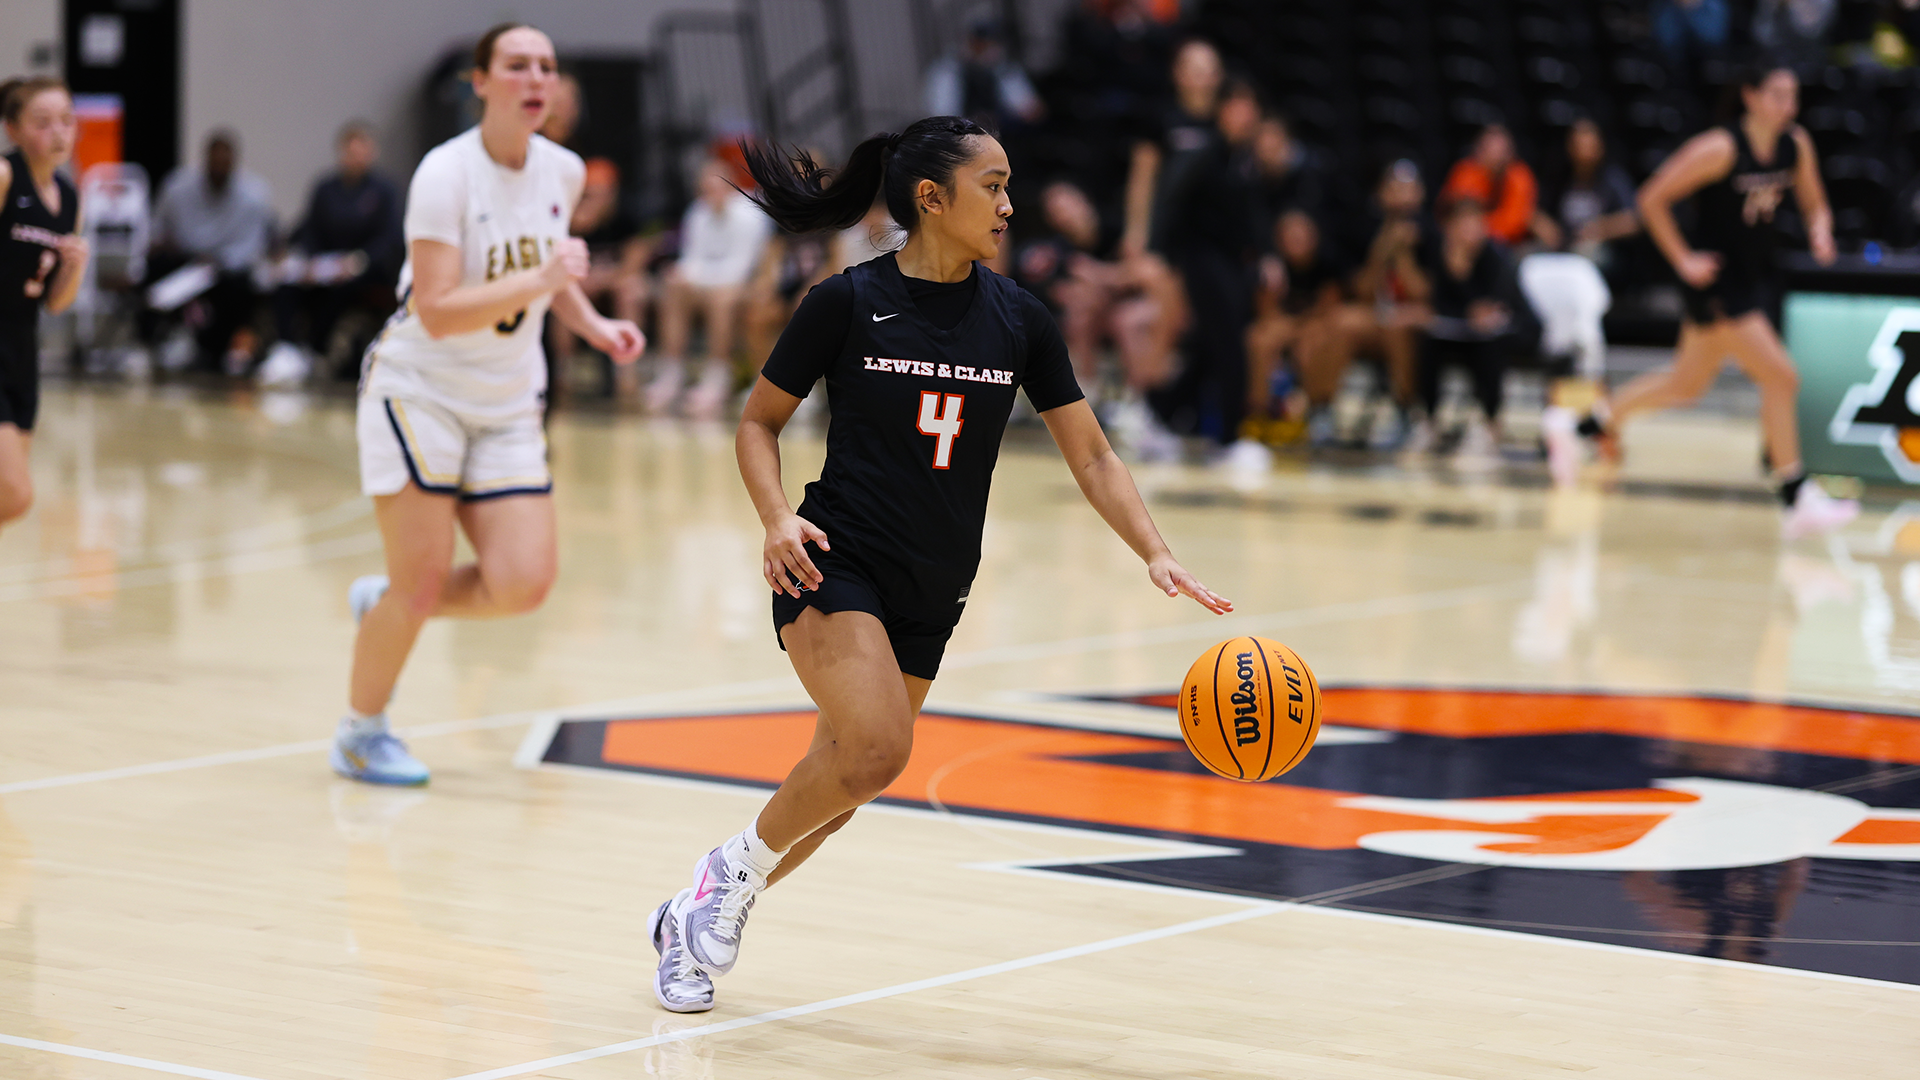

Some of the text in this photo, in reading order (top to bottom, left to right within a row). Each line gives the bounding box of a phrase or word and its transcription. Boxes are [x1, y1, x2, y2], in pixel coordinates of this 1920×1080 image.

[863, 356, 1014, 385] LEWIS & CLARK
[915, 390, 965, 470] 4
[1190, 685, 1199, 718] NFHS
[1230, 651, 1261, 748] Wilson
[1282, 664, 1304, 725] EVO
